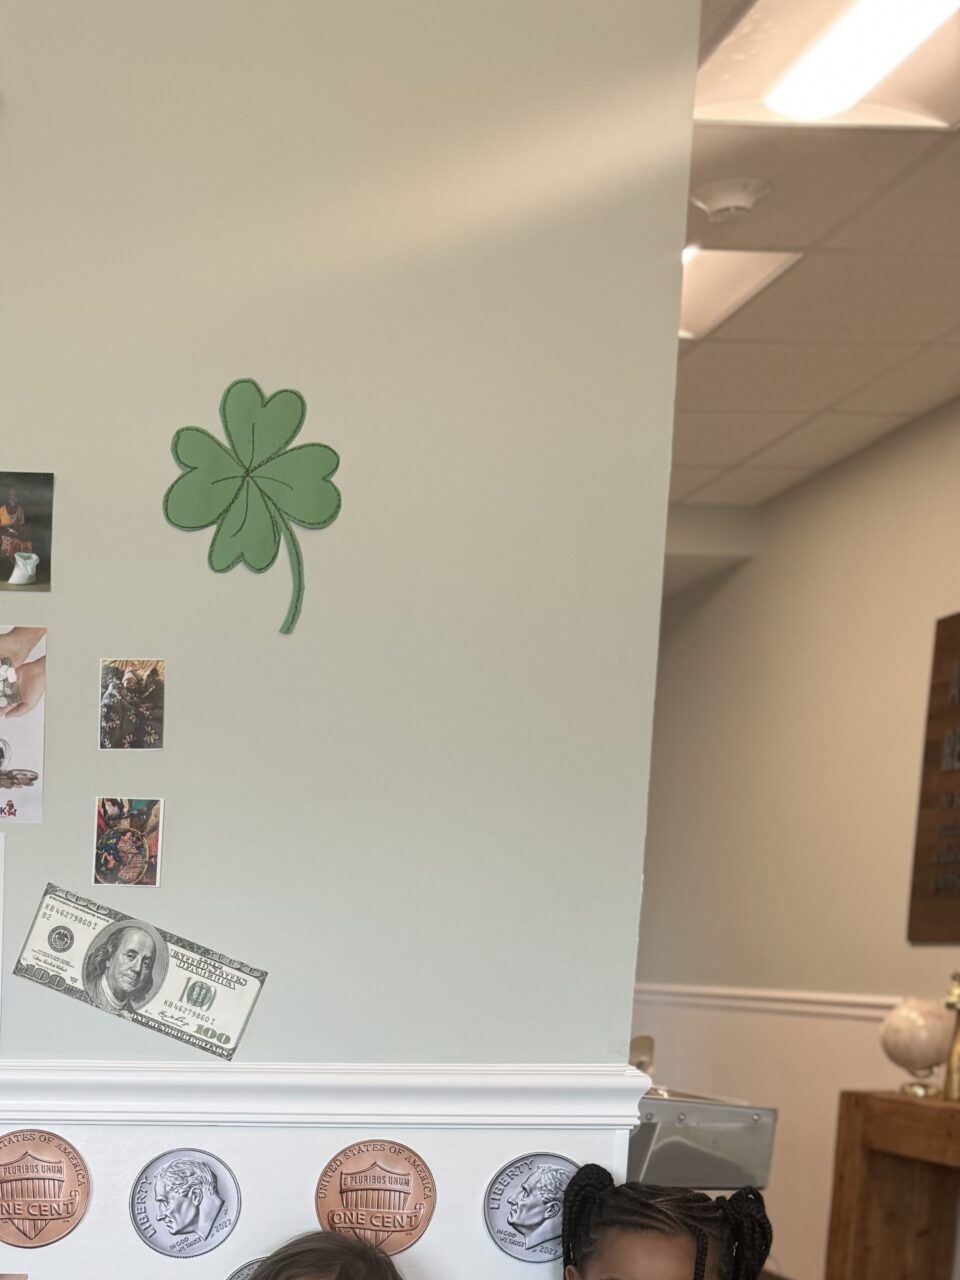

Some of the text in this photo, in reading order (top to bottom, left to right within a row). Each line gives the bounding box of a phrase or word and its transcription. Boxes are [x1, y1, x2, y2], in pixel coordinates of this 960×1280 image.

[26, 963, 66, 989] 100
[194, 1024, 230, 1045] 100
[4, 1165, 38, 1176] PLURIBUS
[41, 1165, 63, 1174] UNUM
[39, 1135, 54, 1144] OF
[55, 1144, 86, 1187] AMERICA
[490, 1159, 534, 1209] LIBERTY
[27, 1203, 74, 1216] CENT
[136, 1176, 157, 1238] LIBERTY
[214, 1219, 233, 1232] 2022
[332, 1211, 417, 1228] ONE CENT
